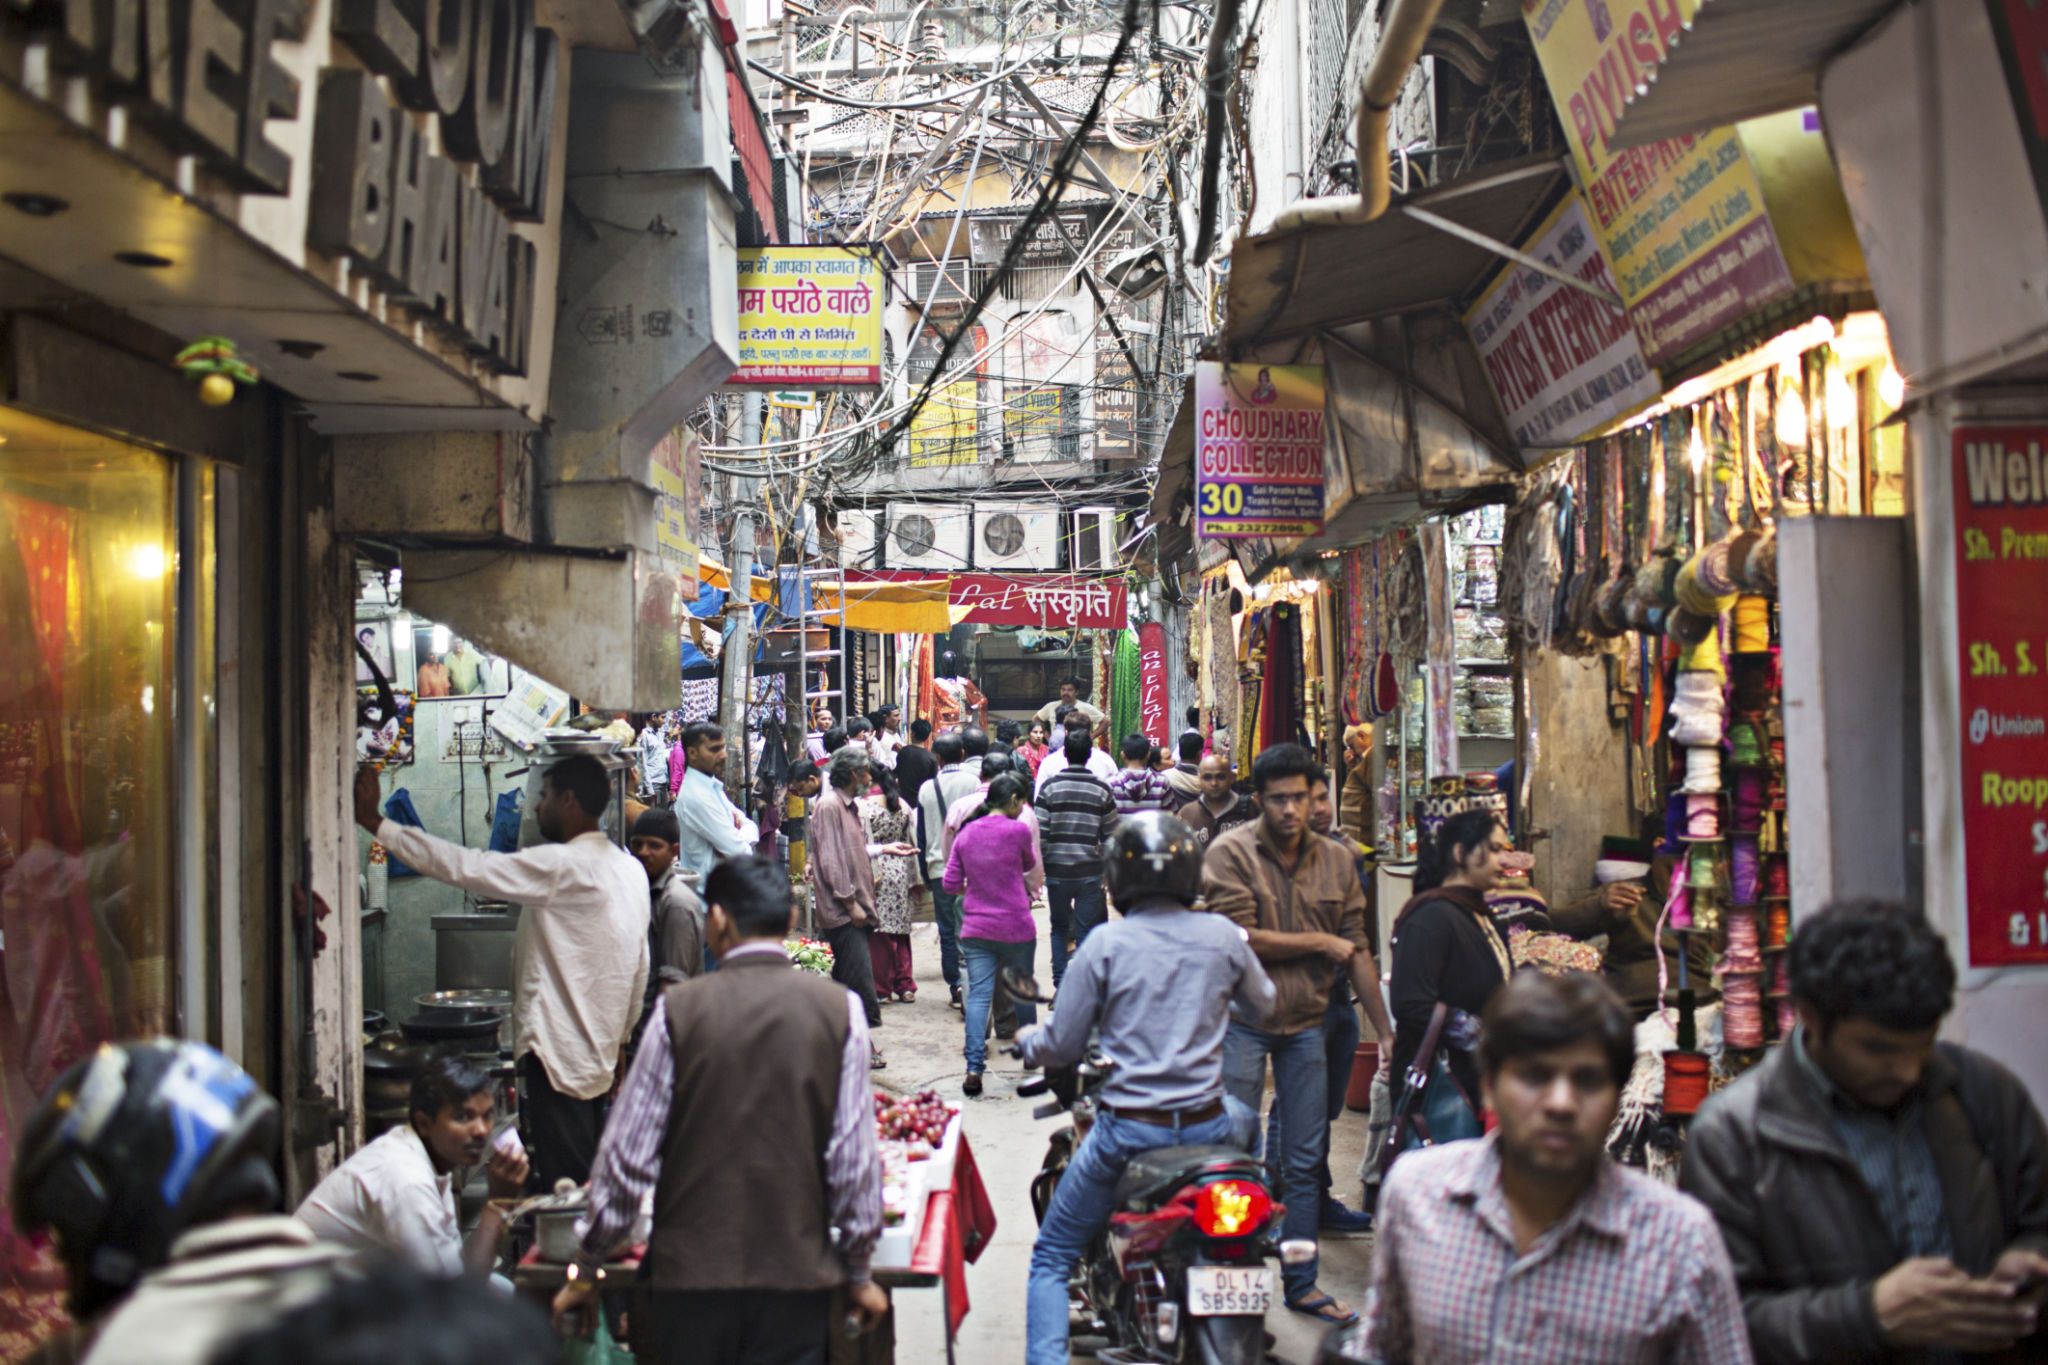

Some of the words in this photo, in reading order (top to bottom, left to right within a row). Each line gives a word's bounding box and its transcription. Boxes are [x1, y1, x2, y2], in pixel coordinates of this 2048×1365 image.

[772, 259, 811, 273] आपका
[815, 259, 855, 273] स्वागत
[771, 278, 822, 314] परांठे
[827, 282, 873, 314] वाले
[751, 328, 777, 340] देसी
[800, 328, 811, 340] से
[815, 327, 855, 340] निर्मित
[1484, 320, 1549, 417] PIYUSH
[1202, 408, 1323, 441] CHOUDHARY
[1202, 444, 1323, 477] COLLECTION
[1965, 441, 2048, 503] Wel
[1201, 483, 1243, 515] 30
[955, 583, 1018, 610] Lal
[1969, 641, 2007, 676] Sh.
[2015, 640, 2037, 676] S.
[1992, 714, 2045, 736] Union
[1201, 1292, 1271, 1311] SB5935
